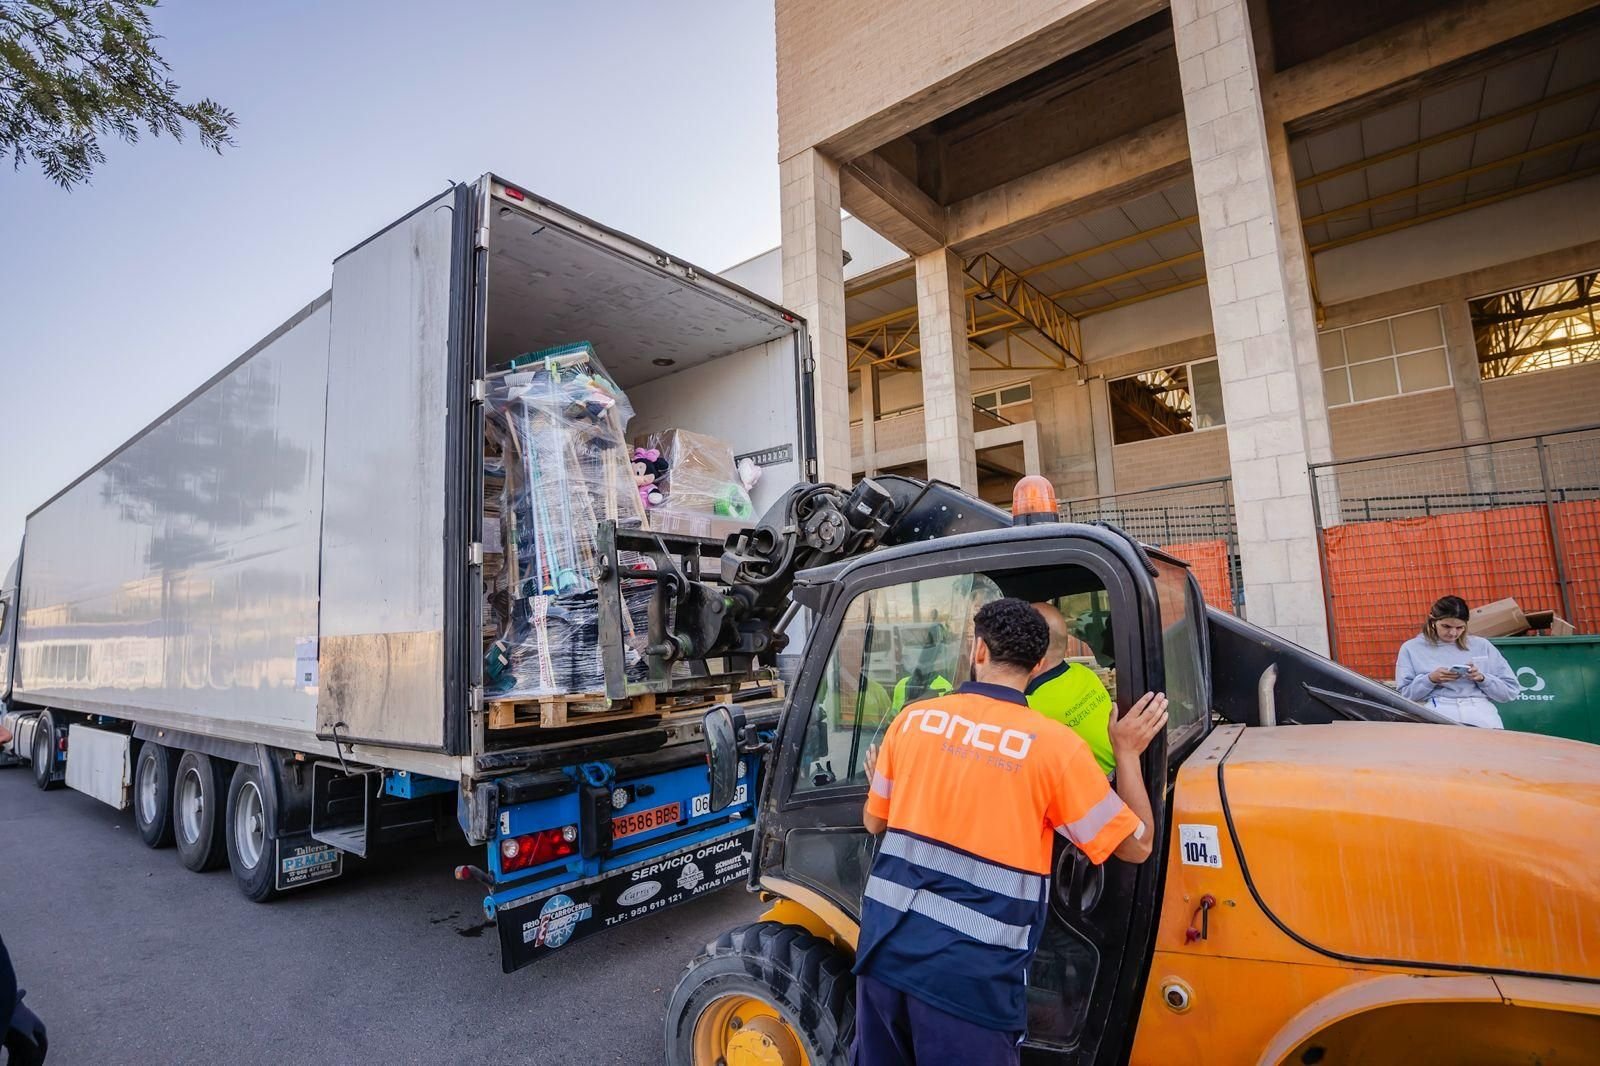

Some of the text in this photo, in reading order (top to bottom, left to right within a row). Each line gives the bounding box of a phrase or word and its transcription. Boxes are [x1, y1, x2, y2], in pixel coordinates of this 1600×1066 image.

[1516, 692, 1555, 700] rbaser
[902, 708, 1032, 760] ronco
[941, 741, 1023, 774] SAFETY FIRST
[695, 797, 709, 812] 06
[619, 810, 653, 836] 8586
[655, 804, 679, 826] BBS
[1198, 831, 1205, 839] L
[284, 850, 336, 872] PEMAR
[631, 853, 694, 882] SERVICIO
[696, 838, 742, 860] OFICIAL
[1184, 842, 1208, 863] 104
[715, 855, 742, 870] SCHMITZ
[715, 861, 742, 875] CARGOBULL
[286, 874, 308, 883] LORCA
[604, 912, 629, 926] TLF:
[630, 904, 648, 918] 950
[649, 899, 667, 911] 619
[667, 892, 684, 904] 121
[691, 878, 721, 895] ANTAS
[523, 919, 540, 930] FRIO
